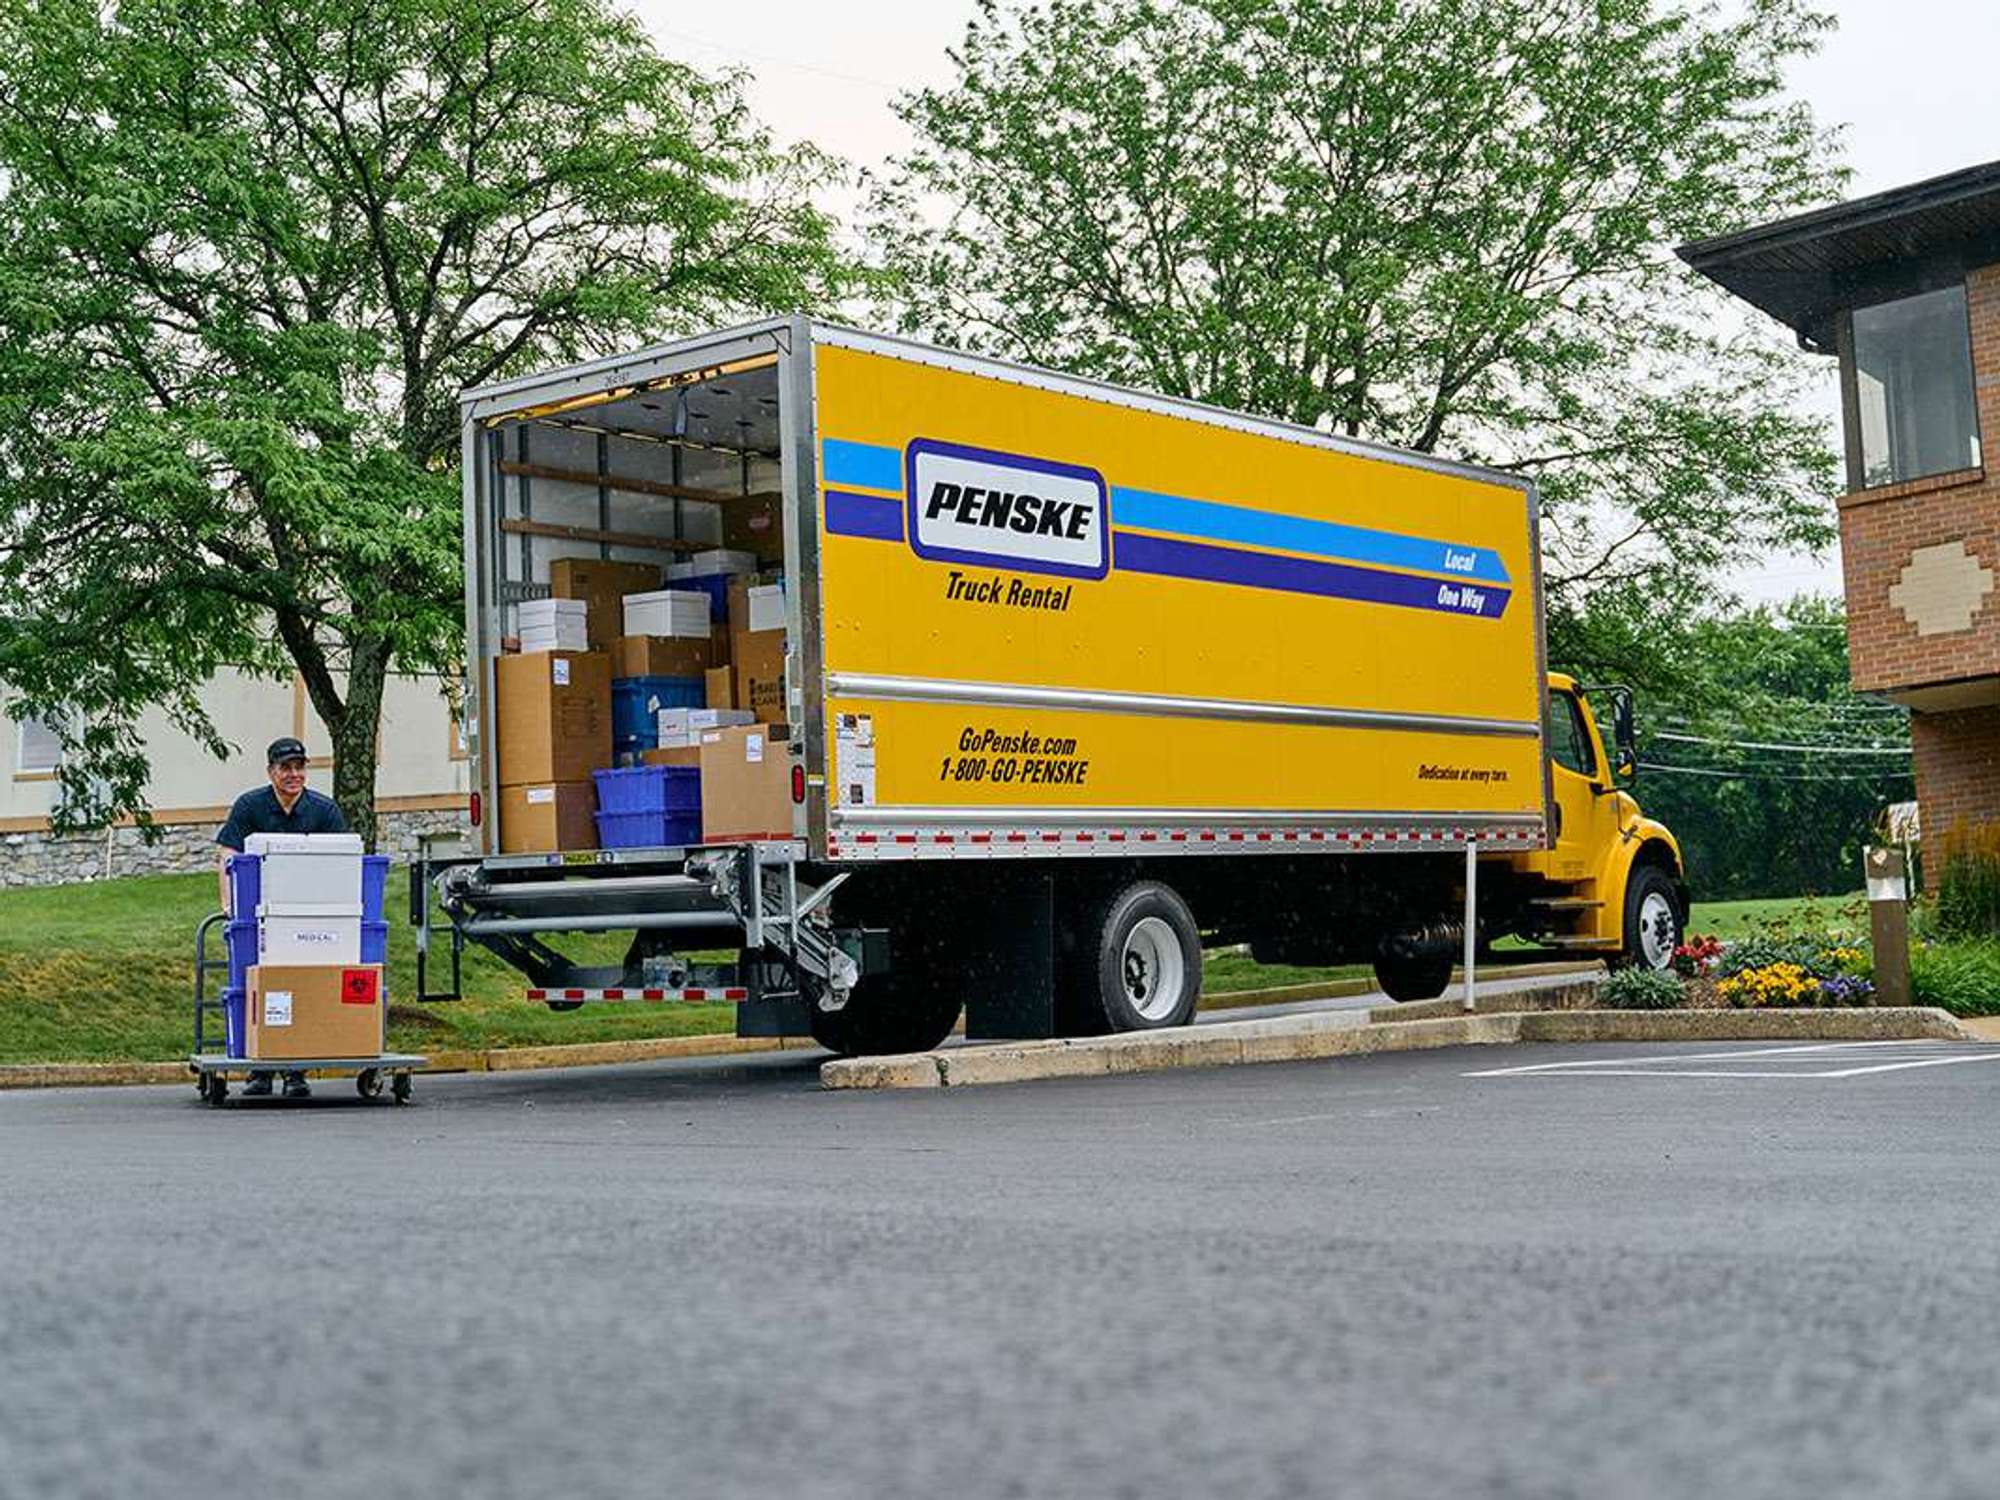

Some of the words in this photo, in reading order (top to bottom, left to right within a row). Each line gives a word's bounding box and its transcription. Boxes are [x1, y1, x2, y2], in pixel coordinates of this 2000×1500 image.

[925, 482, 1093, 540] PENSKE
[1445, 548, 1476, 572] Local
[946, 572, 1003, 604] Truck
[1006, 579, 1072, 611] Rental
[1437, 585, 1459, 607] One
[1461, 587, 1485, 614] Way
[959, 727, 1077, 756] GoPenske.com
[940, 757, 1088, 785] 1-800-GO-PENSKE
[1418, 764, 1459, 781] Dedication
